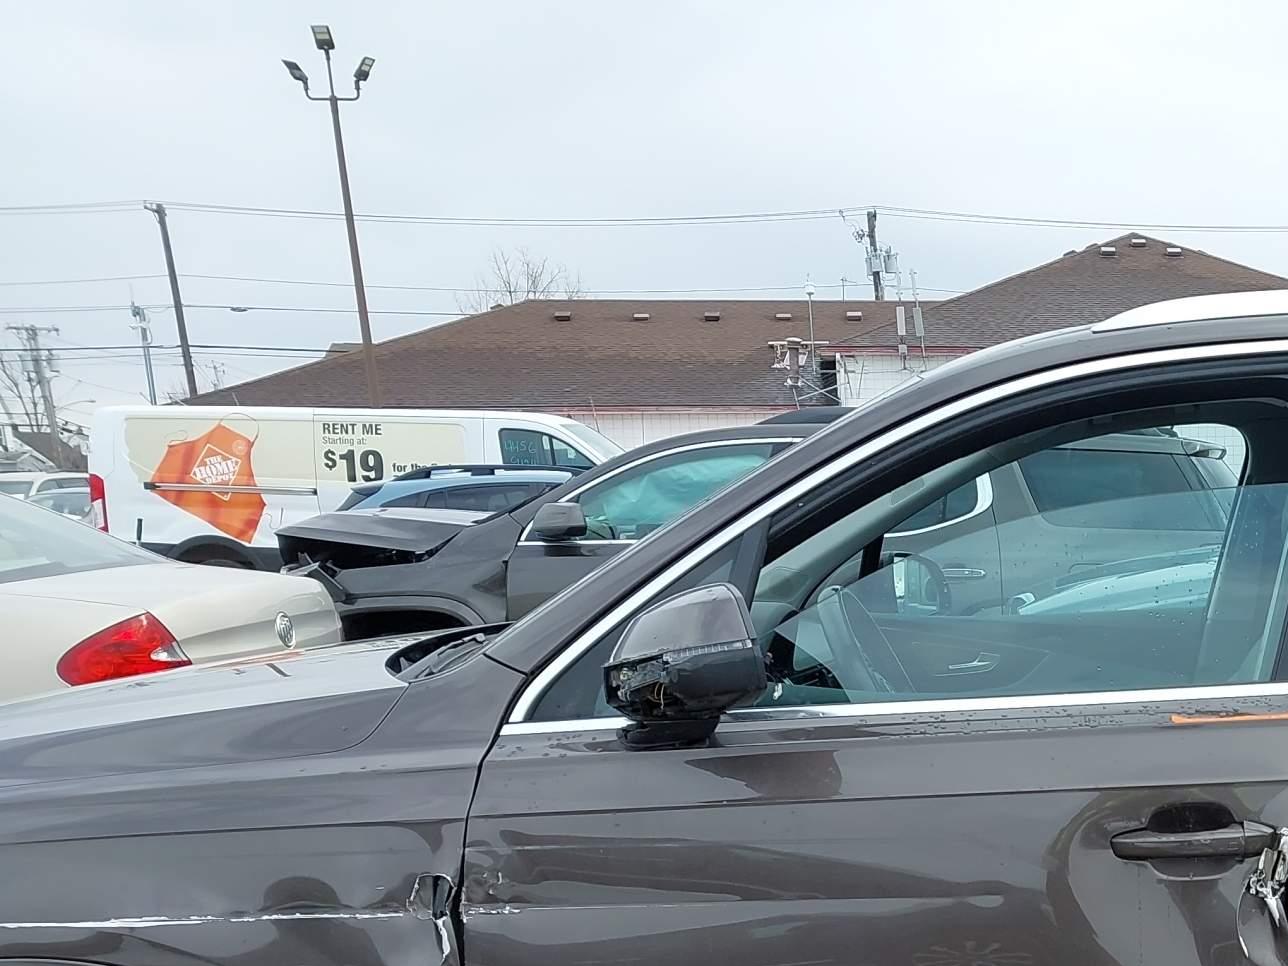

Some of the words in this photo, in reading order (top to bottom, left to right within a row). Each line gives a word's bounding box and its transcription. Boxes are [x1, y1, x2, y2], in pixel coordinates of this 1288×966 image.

[322, 423, 357, 435] RENT
[362, 423, 383, 436] ME
[322, 436, 355, 447] Starting
[357, 437, 367, 446] at:
[204, 455, 222, 466] THE
[323, 448, 384, 483] $19
[195, 458, 239, 480] HOME
[392, 463, 407, 473] for
[205, 472, 235, 485] DEPOT
